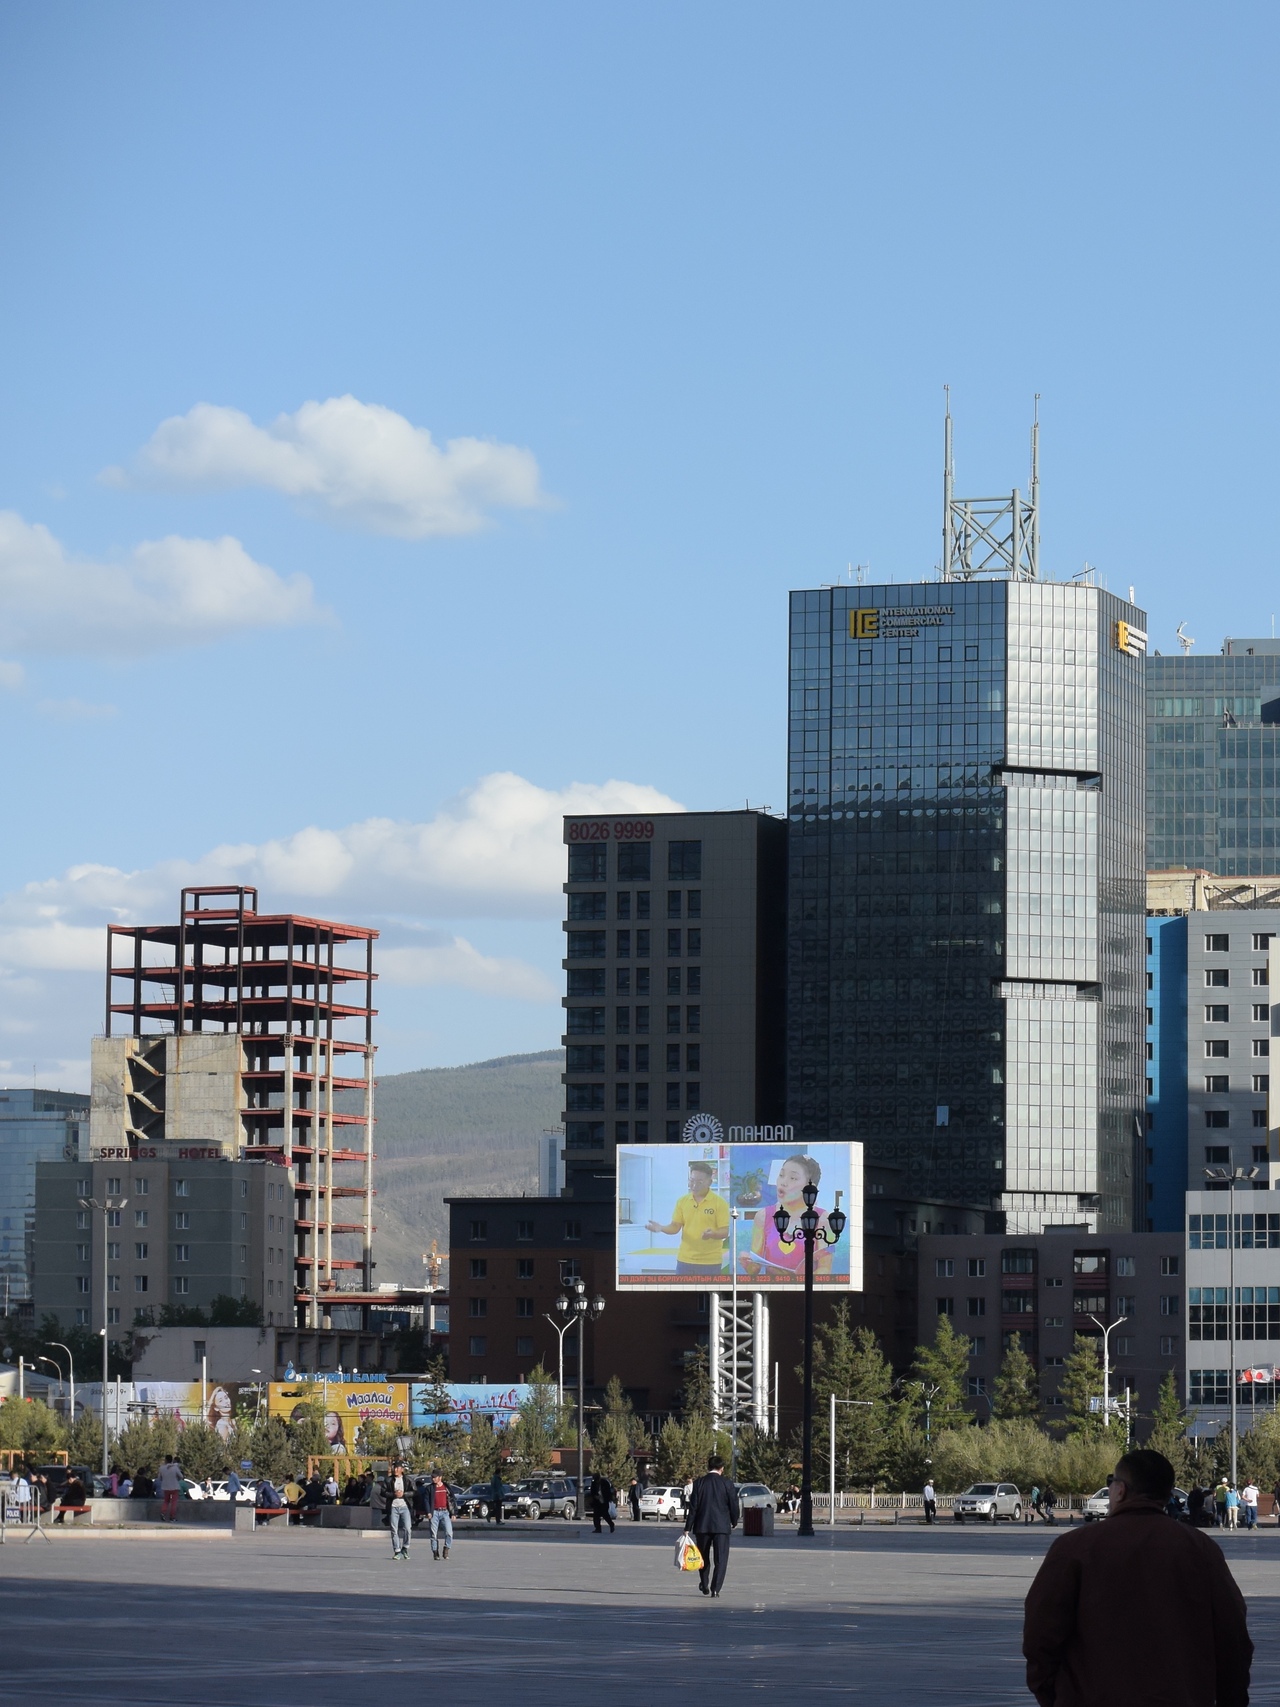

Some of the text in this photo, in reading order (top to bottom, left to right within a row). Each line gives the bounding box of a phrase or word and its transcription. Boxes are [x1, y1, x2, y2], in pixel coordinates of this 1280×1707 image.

[880, 606, 954, 616] INTERNATIONAL
[880, 617, 943, 627] COMMERCIAL
[880, 628, 918, 638] CENTER
[569, 821, 654, 840] 8026 9999
[179, 1147, 222, 1159] HOTEL
